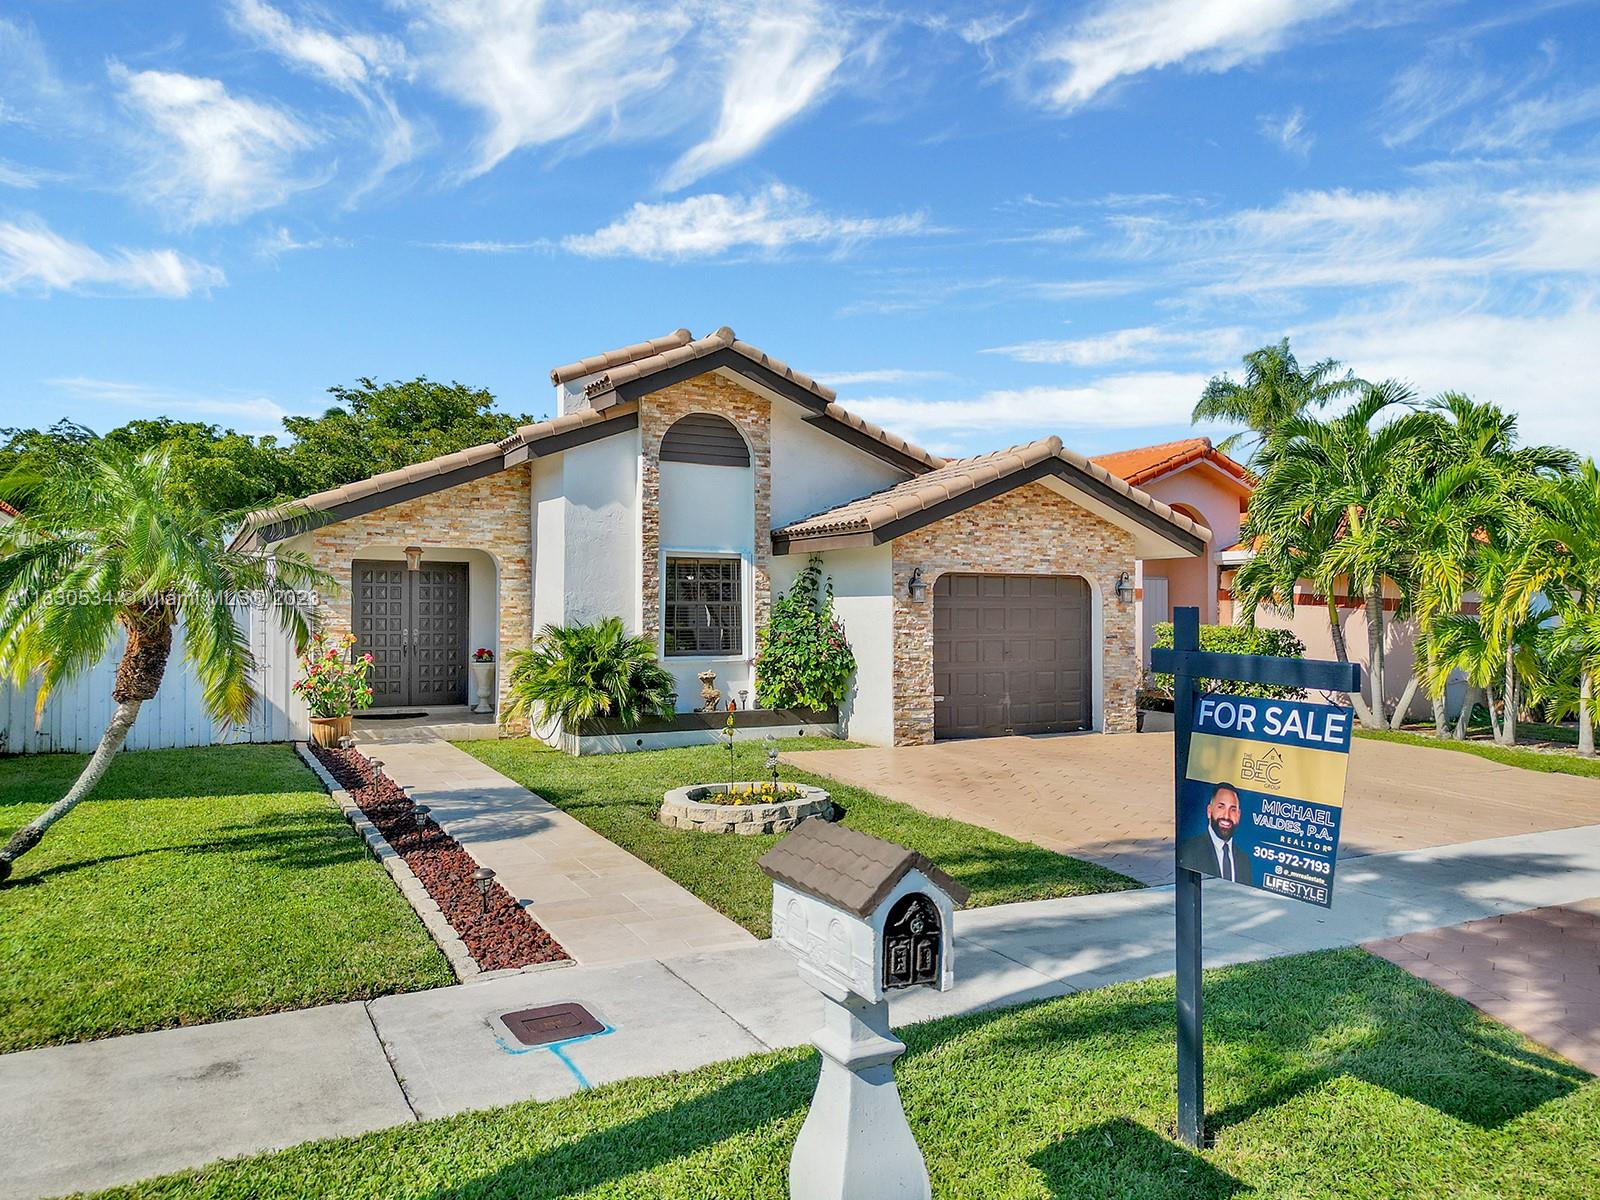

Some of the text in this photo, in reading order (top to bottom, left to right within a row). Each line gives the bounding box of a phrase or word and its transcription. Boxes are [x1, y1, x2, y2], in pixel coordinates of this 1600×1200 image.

[1199, 700, 1346, 744] FOR SALE
[1241, 757, 1283, 784] BEC
[1252, 812, 1334, 841] VALDES, P.A.
[1261, 799, 1335, 827] MICHAEL
[1253, 846, 1330, 874] 305-972-7193
[1265, 875, 1325, 901] LIFESTYLE
